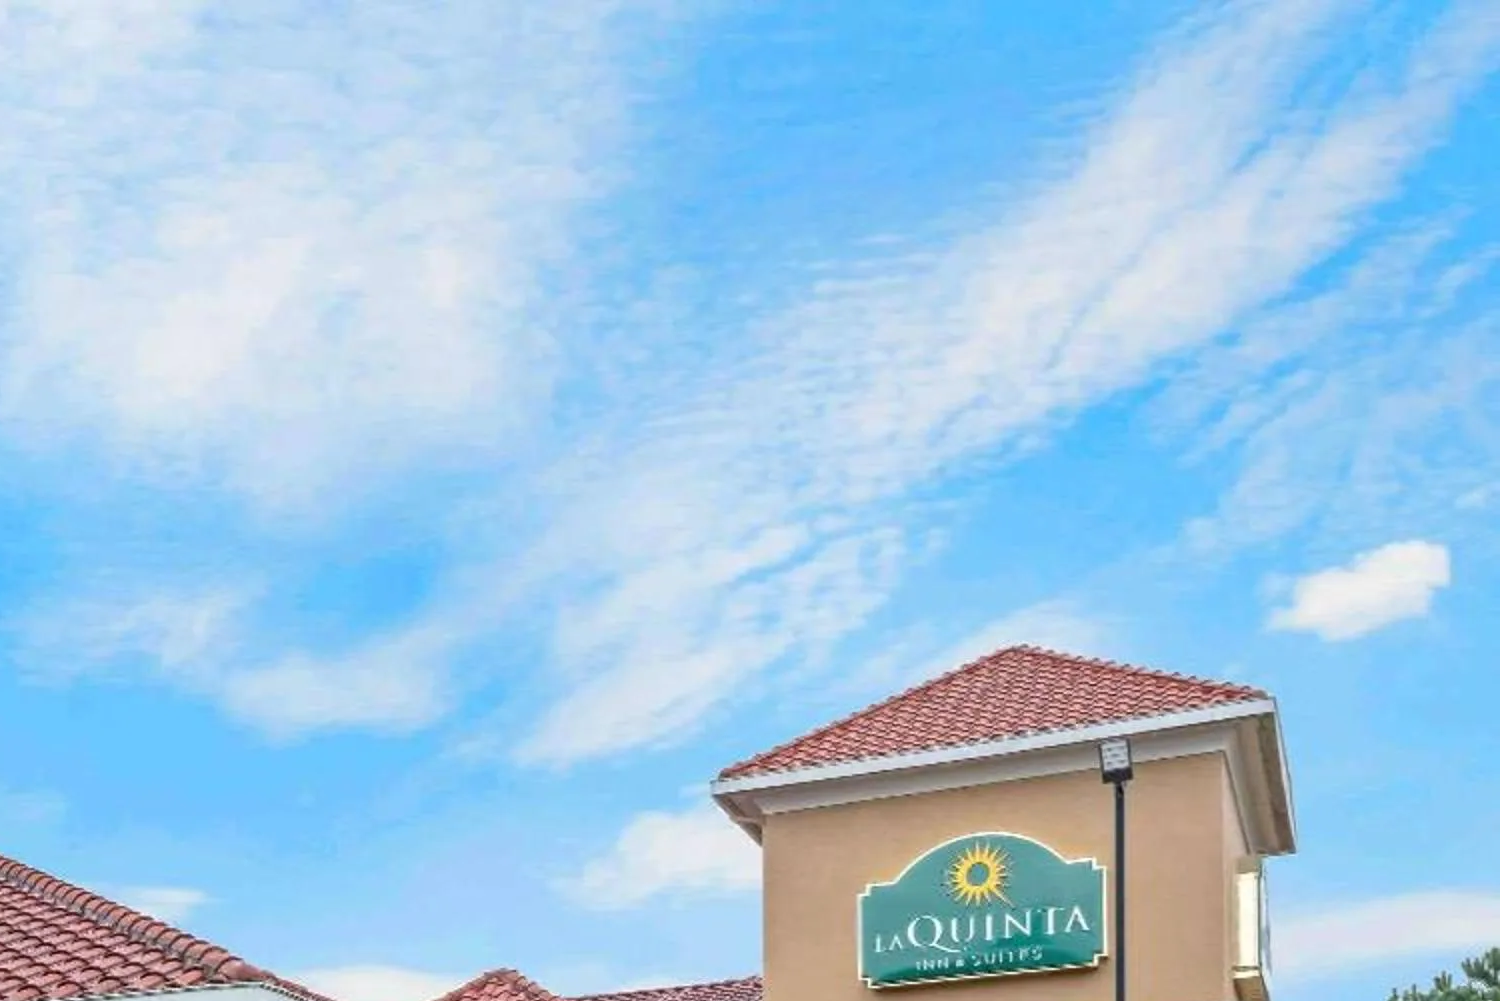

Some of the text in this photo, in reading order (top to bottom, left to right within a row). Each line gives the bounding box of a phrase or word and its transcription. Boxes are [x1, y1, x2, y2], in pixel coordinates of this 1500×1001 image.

[875, 904, 1090, 953] LA QUINTA
[915, 957, 949, 971] INN
[969, 945, 1043, 966] SUITES
